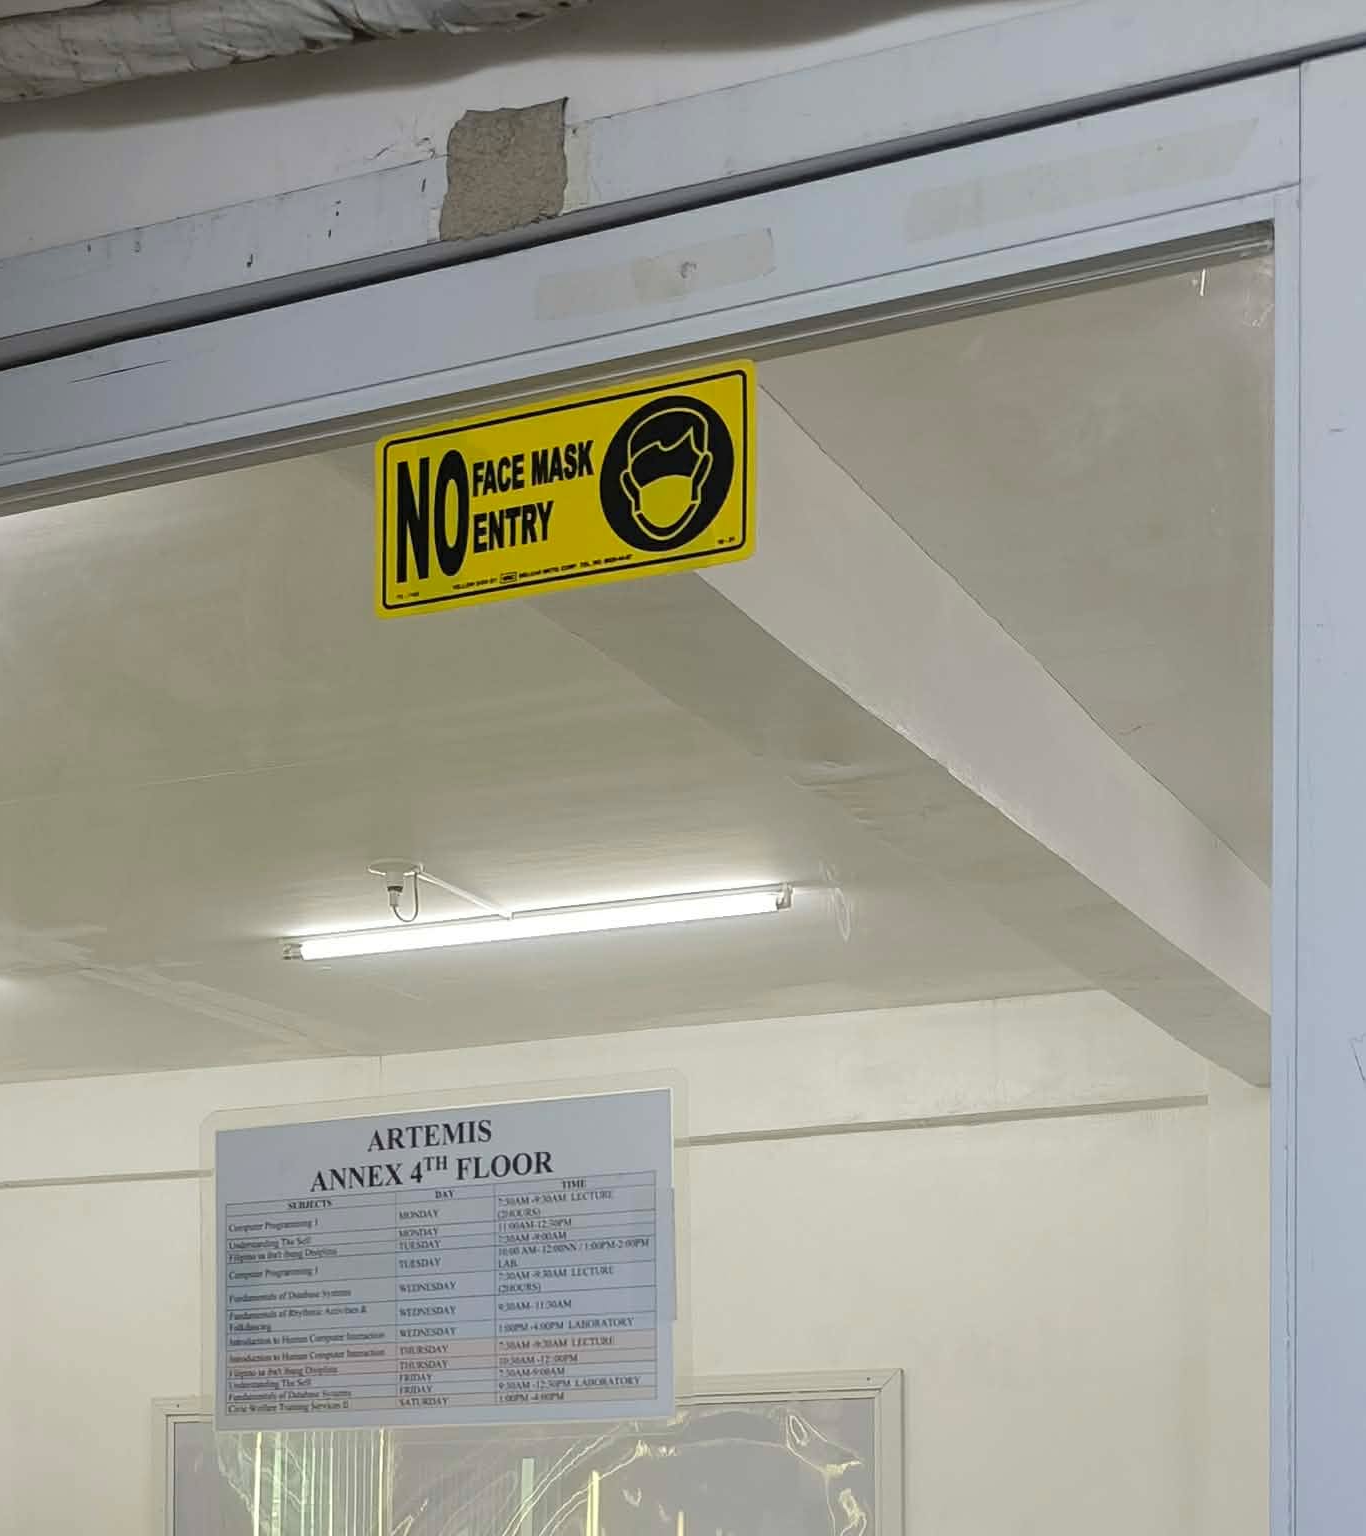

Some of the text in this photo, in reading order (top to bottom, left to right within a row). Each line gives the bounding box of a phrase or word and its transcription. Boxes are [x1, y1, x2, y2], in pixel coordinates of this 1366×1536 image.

[472, 440, 594, 496] FACE MASK
[396, 450, 469, 583] NO
[473, 501, 554, 553] ENTRY
[367, 1118, 492, 1152] ARTEMIS
[309, 1149, 554, 1192] ANNEX 4TH FLOOR
[434, 1188, 454, 1199] DAY
[562, 1178, 587, 1189] TIME
[398, 1280, 458, 1293] WEDNESDAY
[399, 1305, 457, 1318] WEDNESDAY
[399, 1326, 457, 1338] WEDNESDAY
